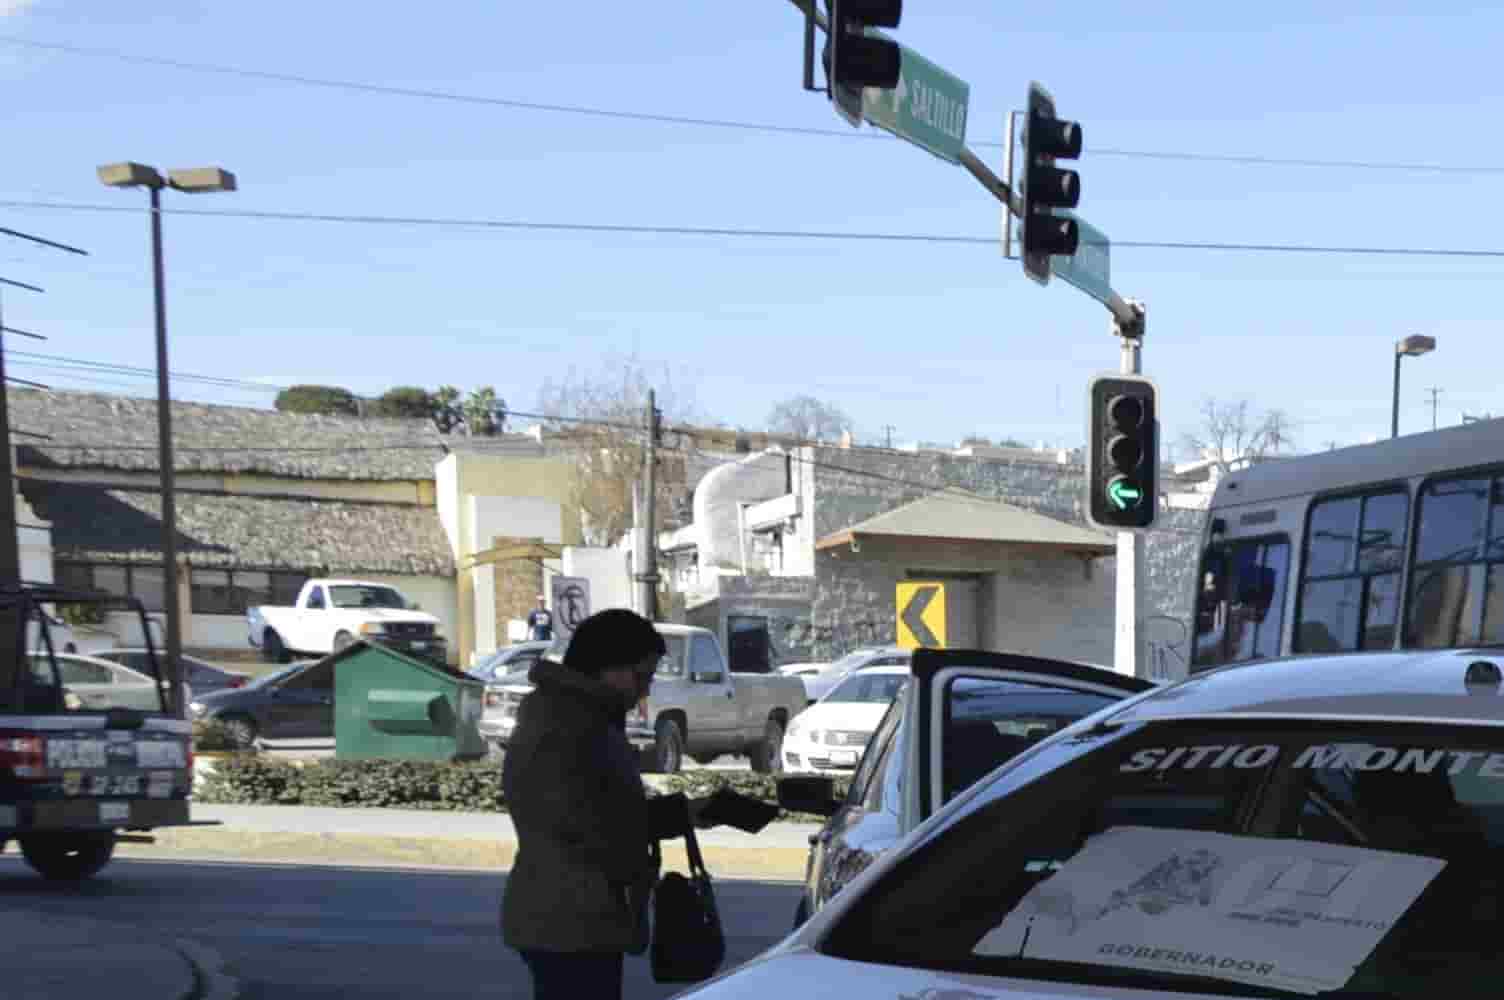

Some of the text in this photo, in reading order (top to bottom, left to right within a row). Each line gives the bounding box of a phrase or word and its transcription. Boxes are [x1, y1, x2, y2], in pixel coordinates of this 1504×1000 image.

[911, 80, 964, 139] SALTILLO
[1120, 743, 1281, 773] SITIO
[1097, 943, 1276, 976] GOBERNADOR
